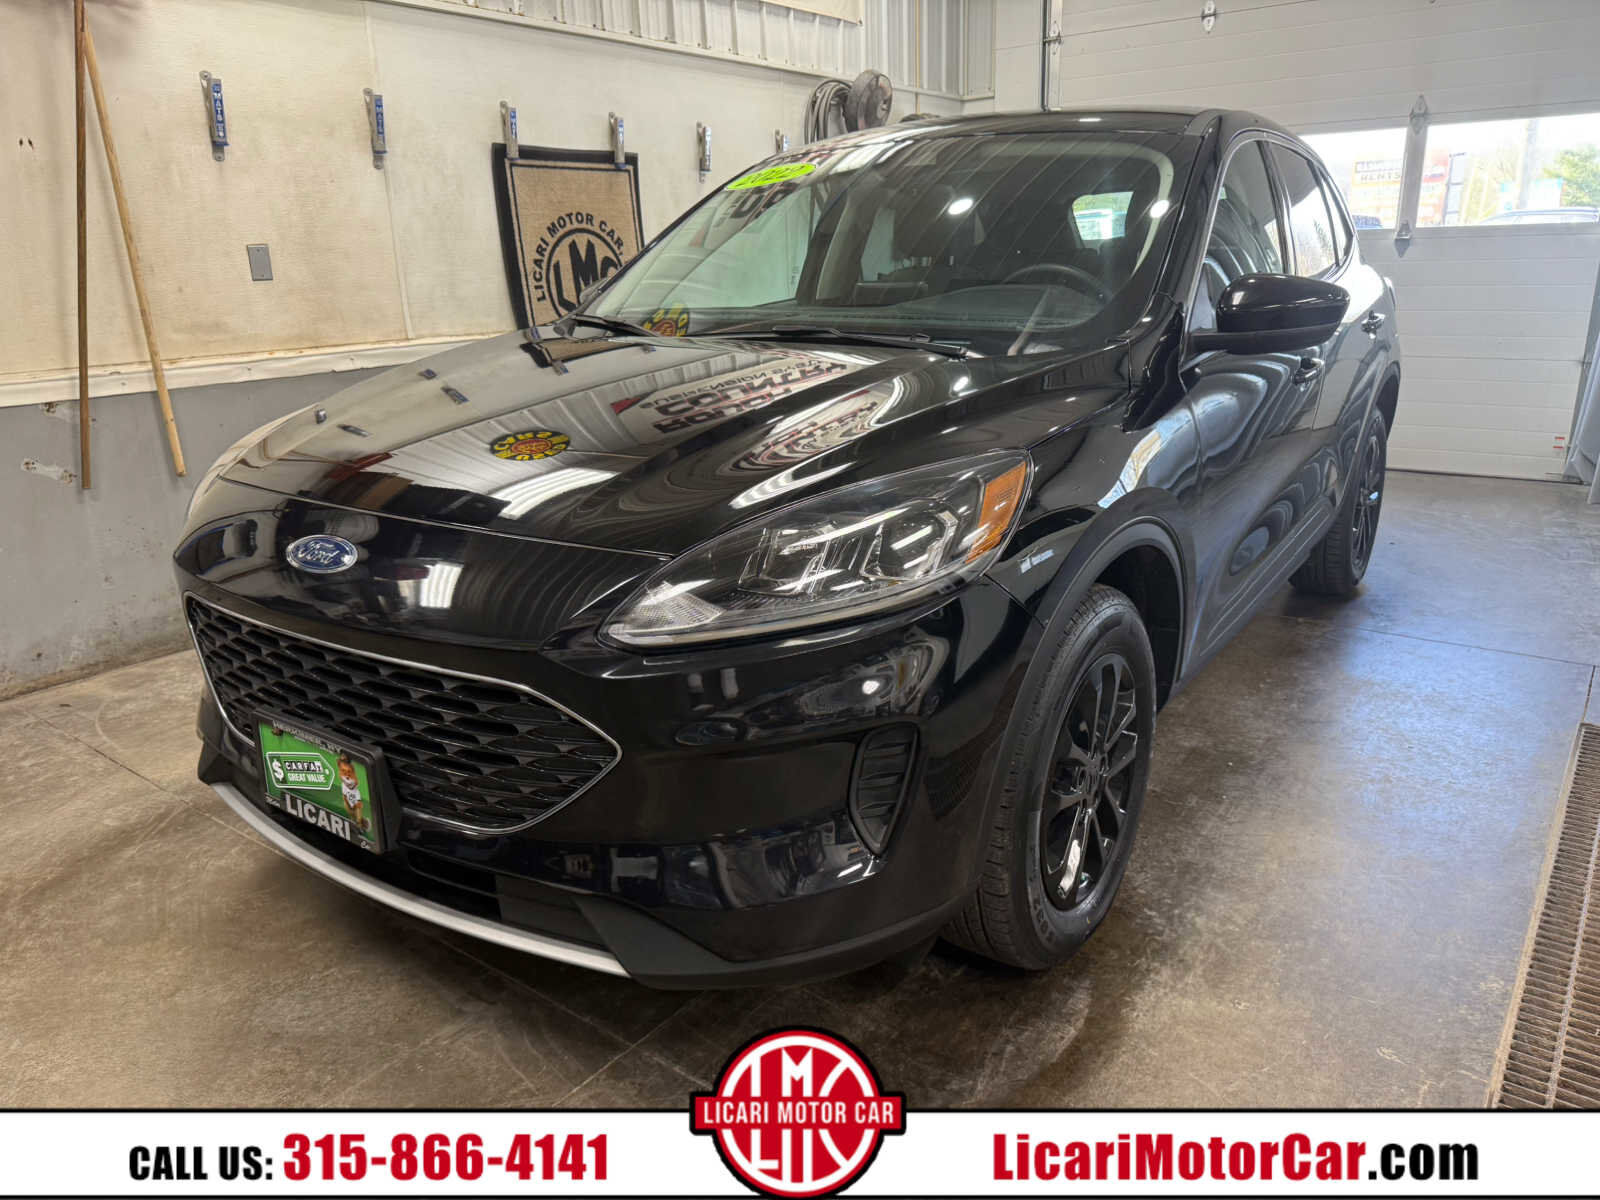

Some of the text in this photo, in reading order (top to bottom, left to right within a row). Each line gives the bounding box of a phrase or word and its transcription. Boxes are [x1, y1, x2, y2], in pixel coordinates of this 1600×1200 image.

[533, 237, 551, 302] LICARI
[547, 212, 595, 238] MOTOR
[297, 540, 340, 564] Ford
[285, 793, 351, 840] LICARI
